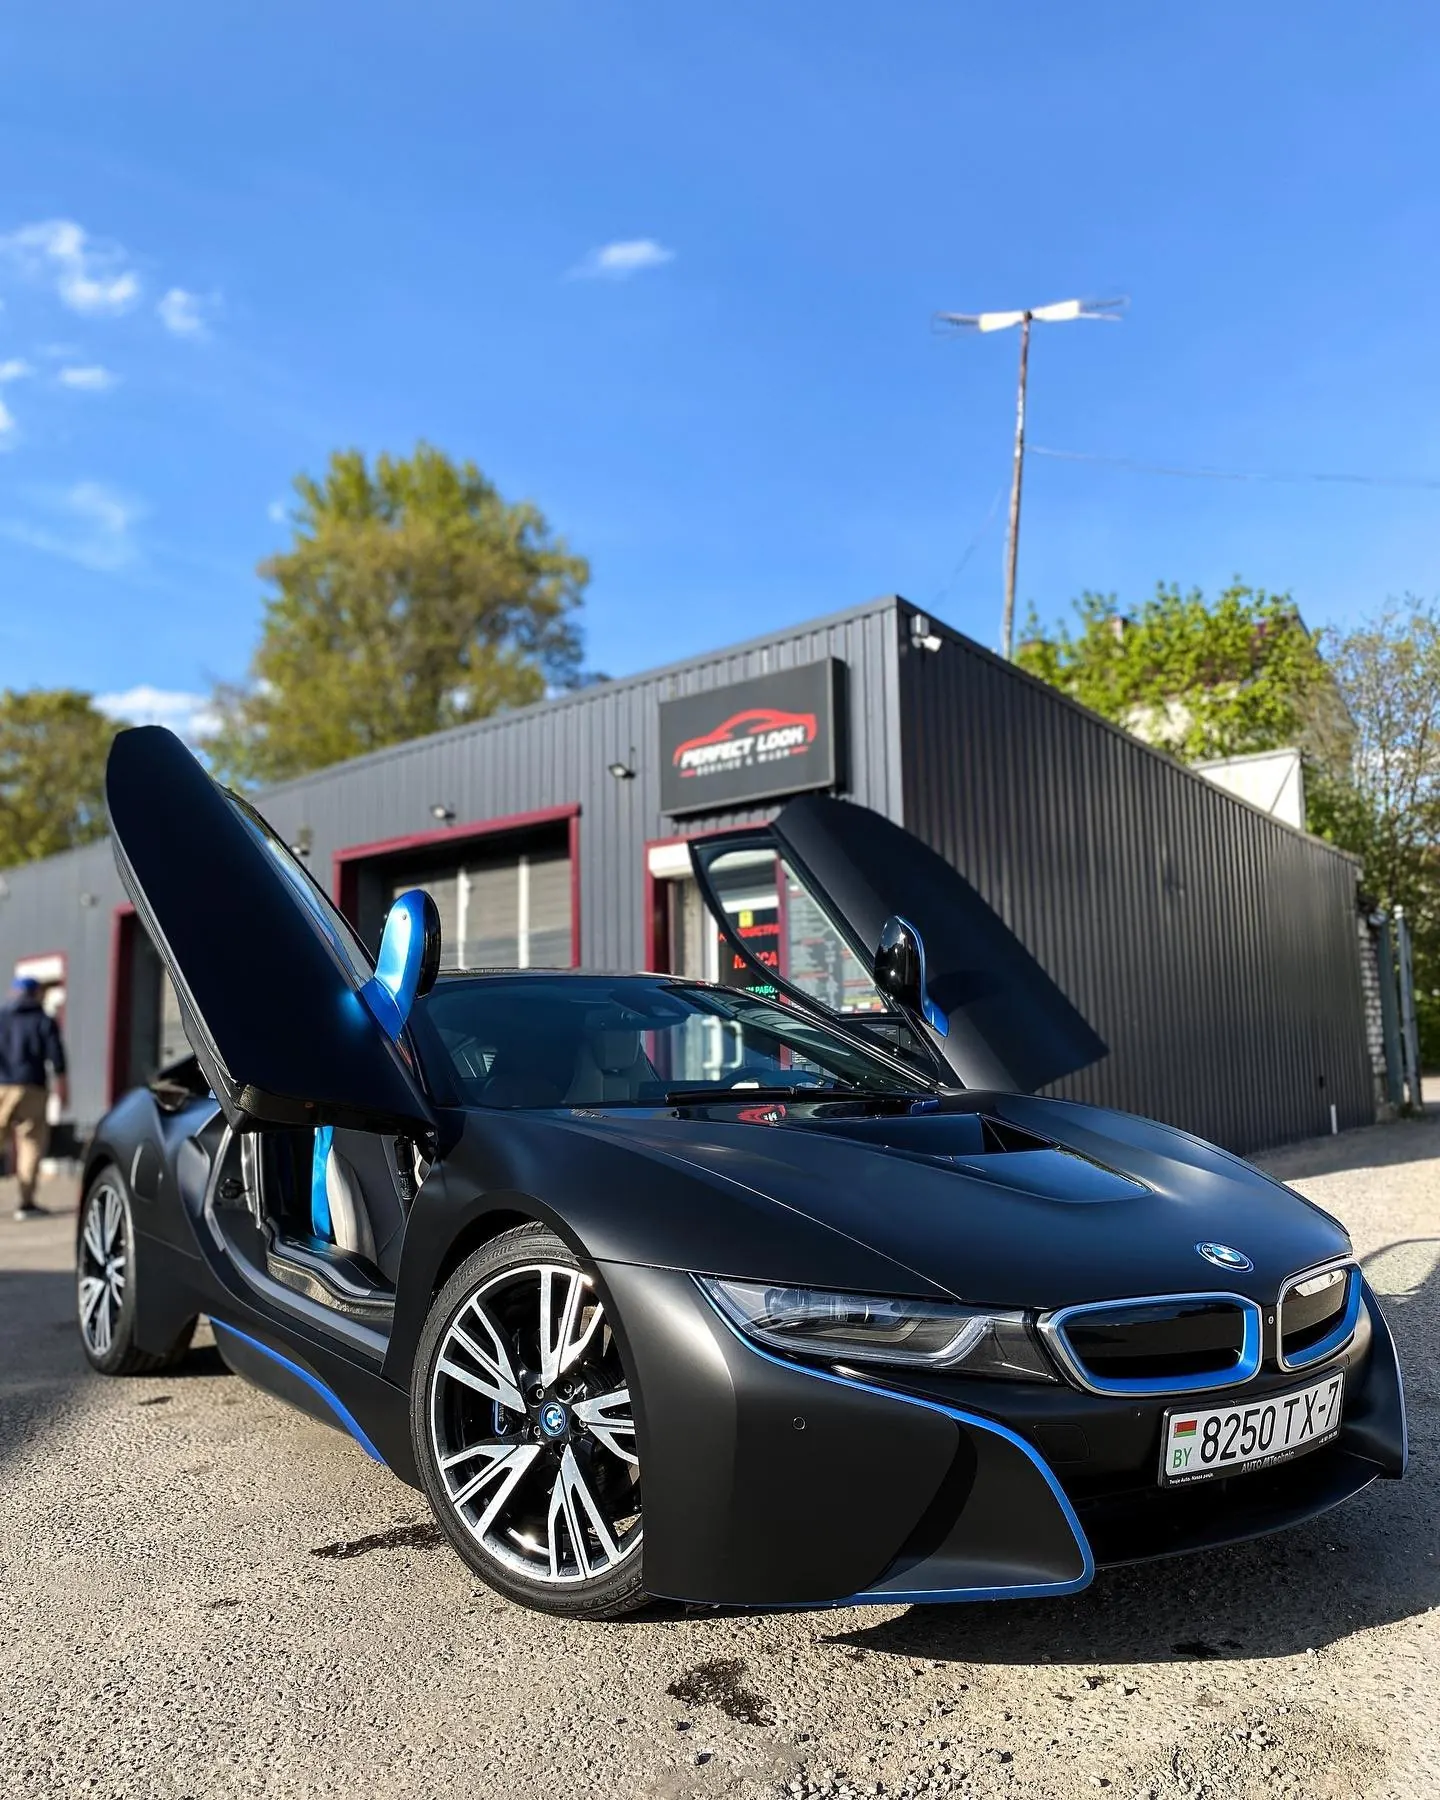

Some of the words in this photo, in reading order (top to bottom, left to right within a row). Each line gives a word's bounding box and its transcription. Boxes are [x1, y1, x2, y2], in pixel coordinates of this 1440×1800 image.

[681, 737, 754, 769] PERFECT
[1200, 1405, 1276, 1464] 8250
[1283, 1380, 1340, 1444] TX-7
[1173, 1447, 1192, 1468] BY
